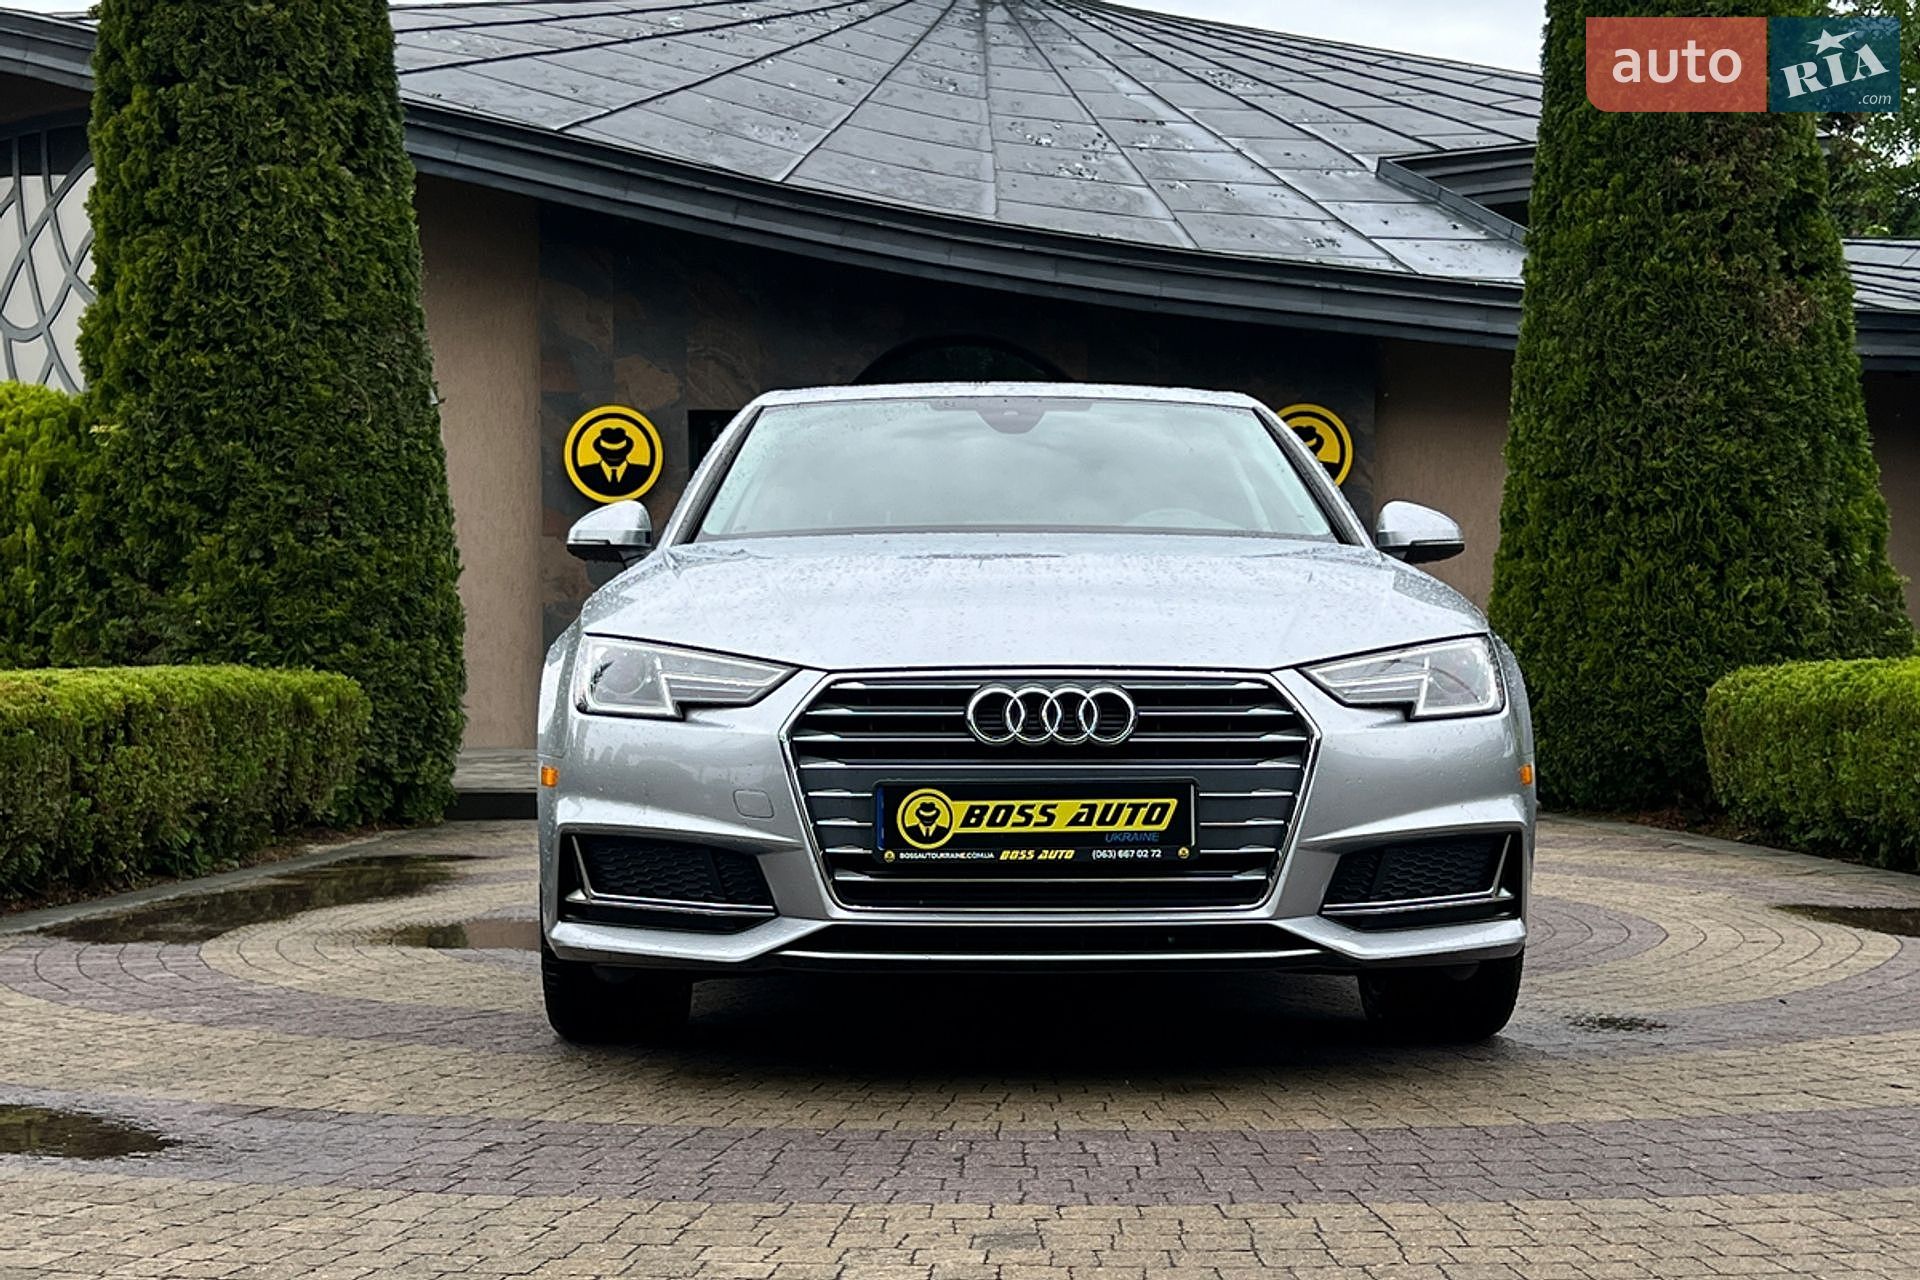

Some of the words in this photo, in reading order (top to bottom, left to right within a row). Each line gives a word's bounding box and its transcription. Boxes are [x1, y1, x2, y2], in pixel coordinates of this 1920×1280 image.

[959, 803, 1059, 828] BOSS
[1065, 801, 1174, 827] AUTO
[1105, 832, 1160, 843] UKRAINE
[999, 850, 1035, 860] BOSS
[1037, 849, 1075, 860] AUTO
[1091, 849, 1117, 861] (063)
[1136, 849, 1149, 859] 02
[1150, 848, 1162, 859] 72
